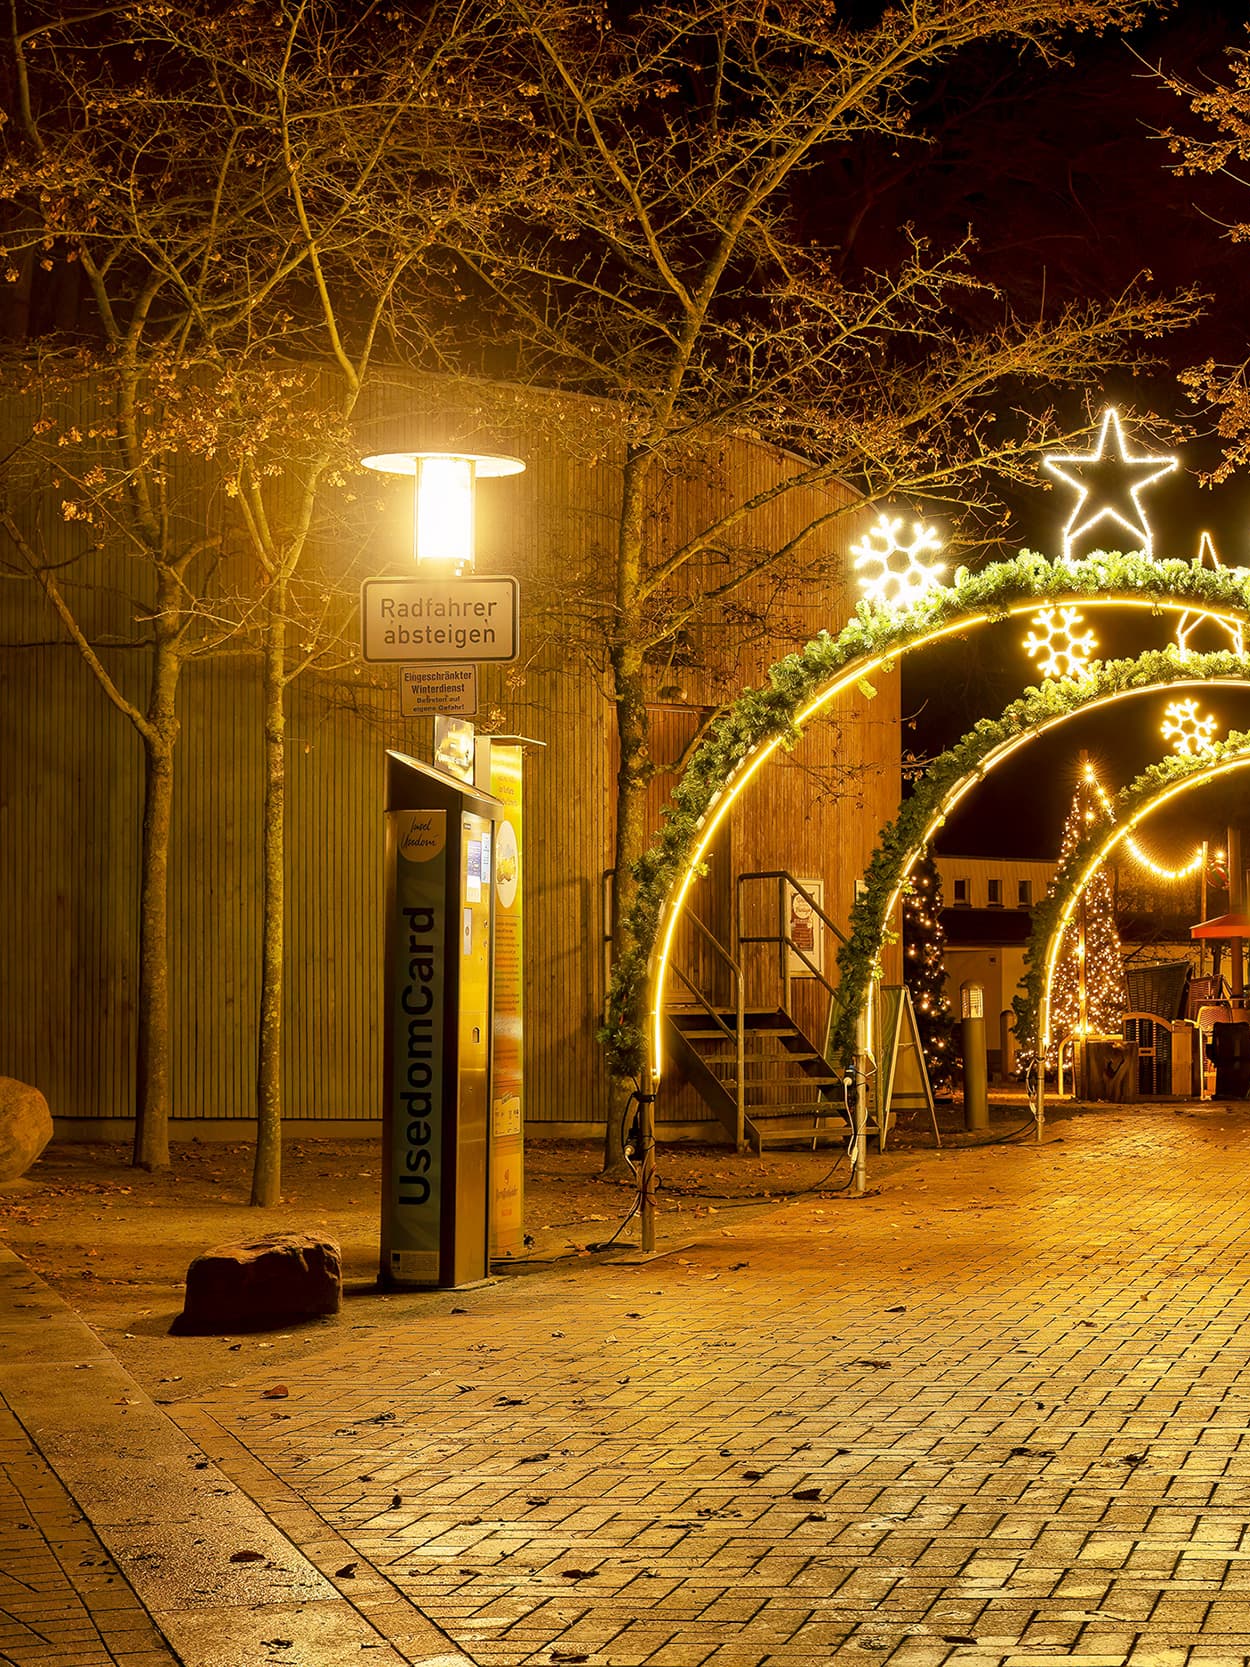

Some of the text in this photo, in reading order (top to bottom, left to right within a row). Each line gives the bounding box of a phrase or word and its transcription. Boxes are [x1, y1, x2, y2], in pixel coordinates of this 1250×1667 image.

[381, 597, 497, 618] Radfahrer
[384, 624, 496, 649] absteigen
[404, 671, 472, 683] Eingeschränkter
[411, 684, 465, 694] Winterdienst
[398, 907, 435, 1205] UsedomCard
